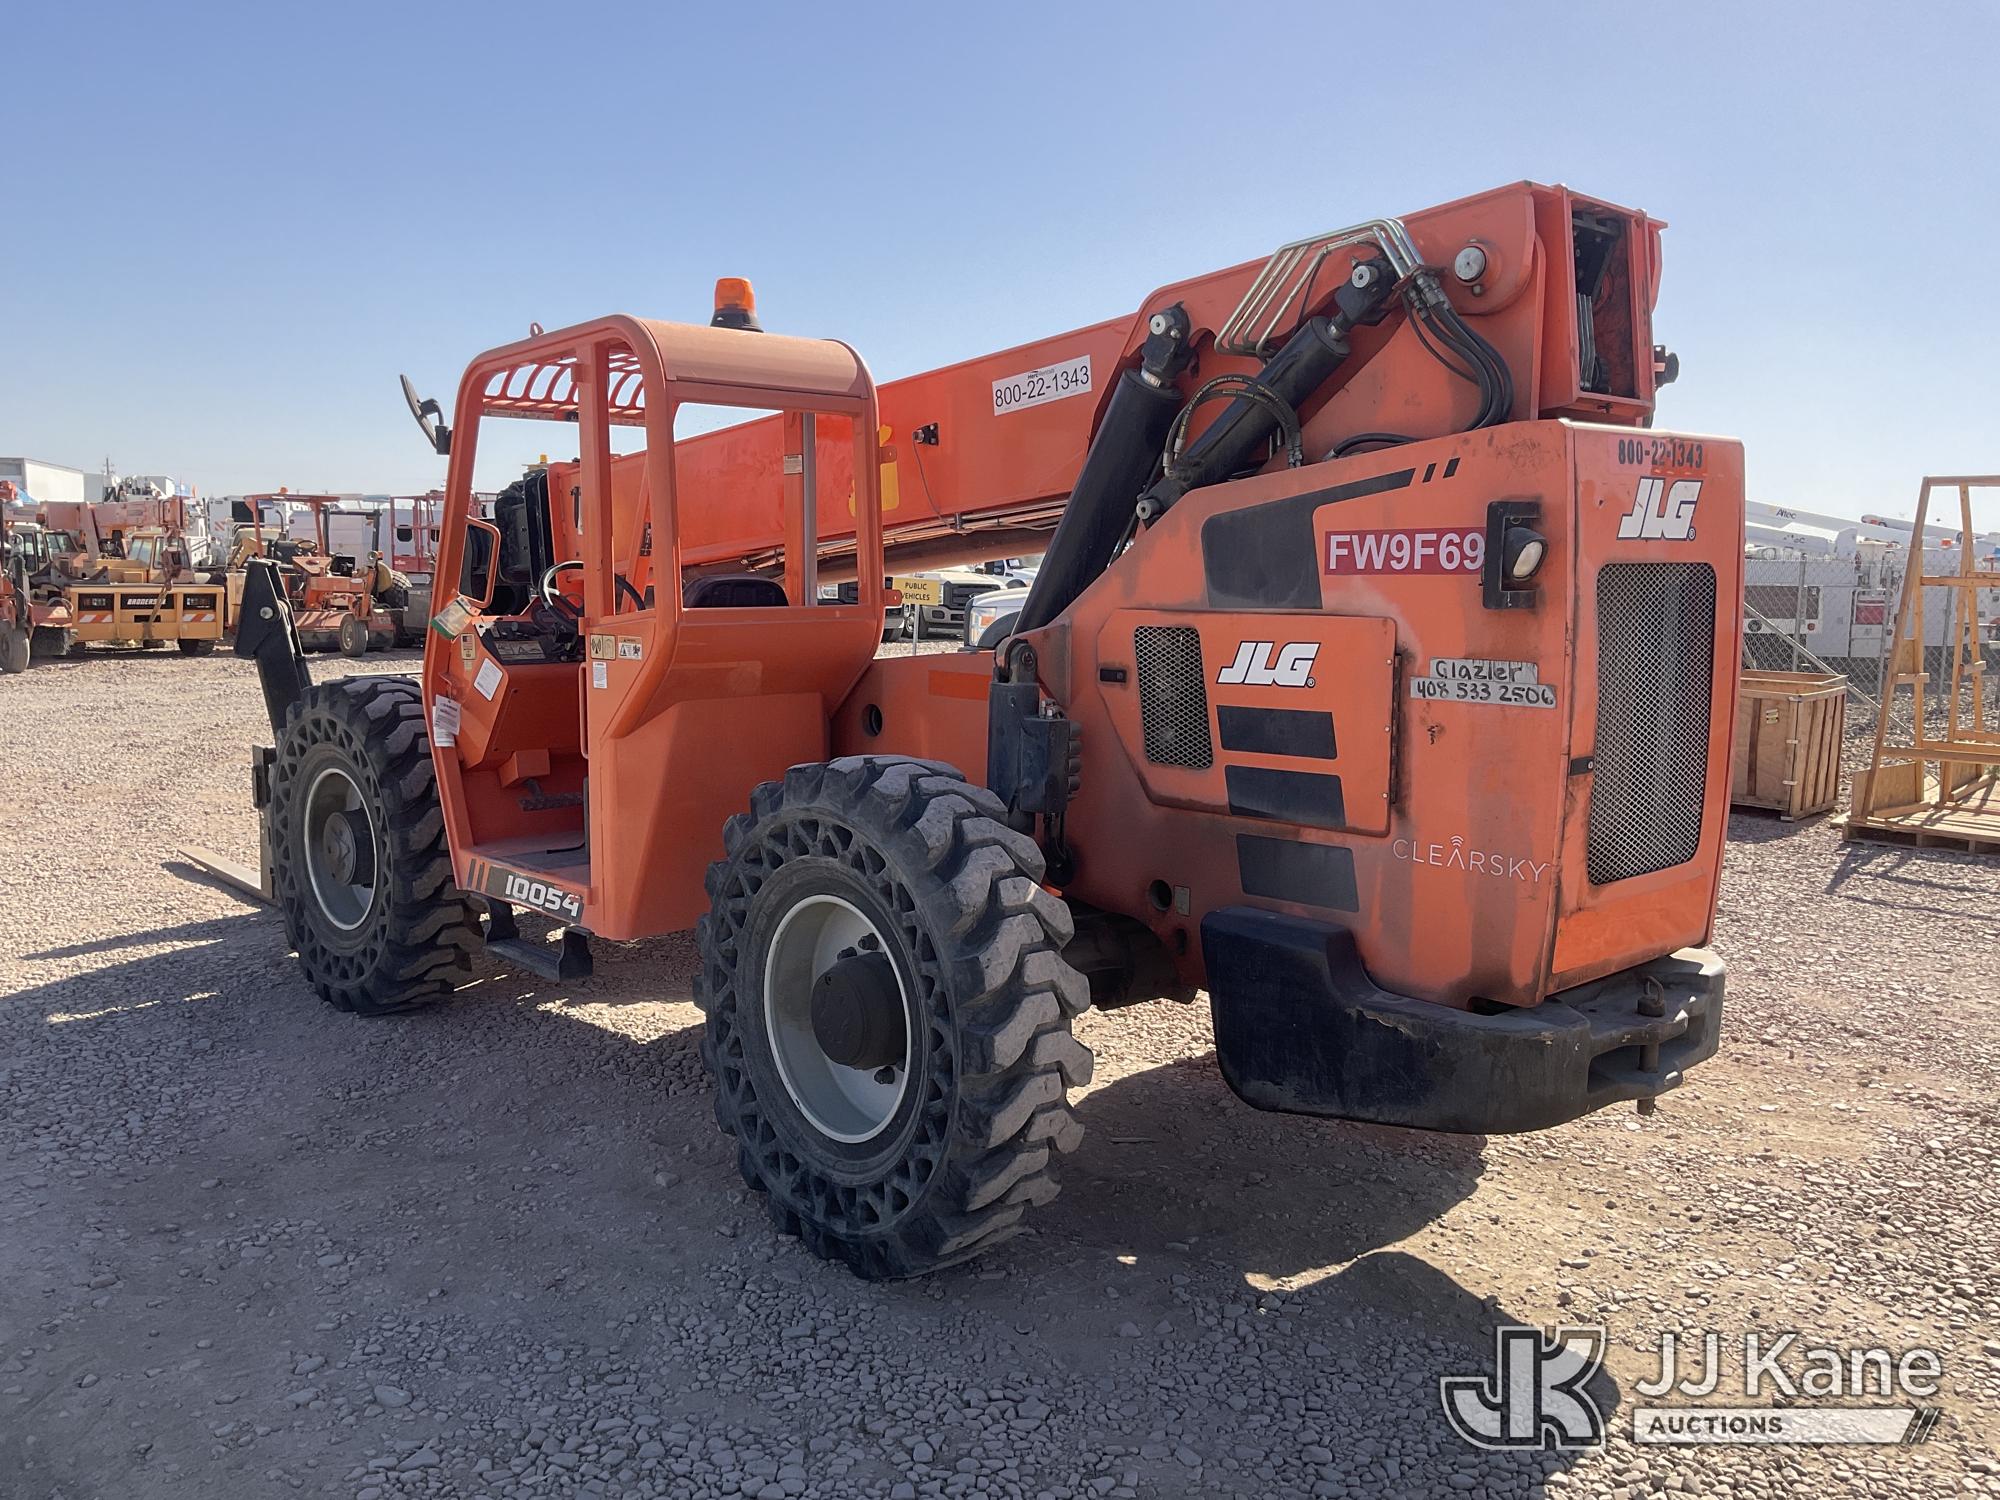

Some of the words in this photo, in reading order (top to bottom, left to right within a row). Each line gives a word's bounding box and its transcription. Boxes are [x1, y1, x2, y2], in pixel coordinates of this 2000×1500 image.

[995, 365, 1090, 407] 800-22-1343
[1618, 439, 1703, 469] 800-22-1343
[1616, 476, 1703, 541] JLG
[1329, 532, 1485, 570] FW9F69
[905, 581, 927, 590] PUBLIC
[1216, 640, 1321, 688] JLG
[1416, 680, 1450, 698] 408
[1456, 682, 1492, 701] 533
[1499, 685, 1555, 705] 2506
[1392, 838, 1549, 883] CLEARSKY
[505, 874, 581, 917] 10054
